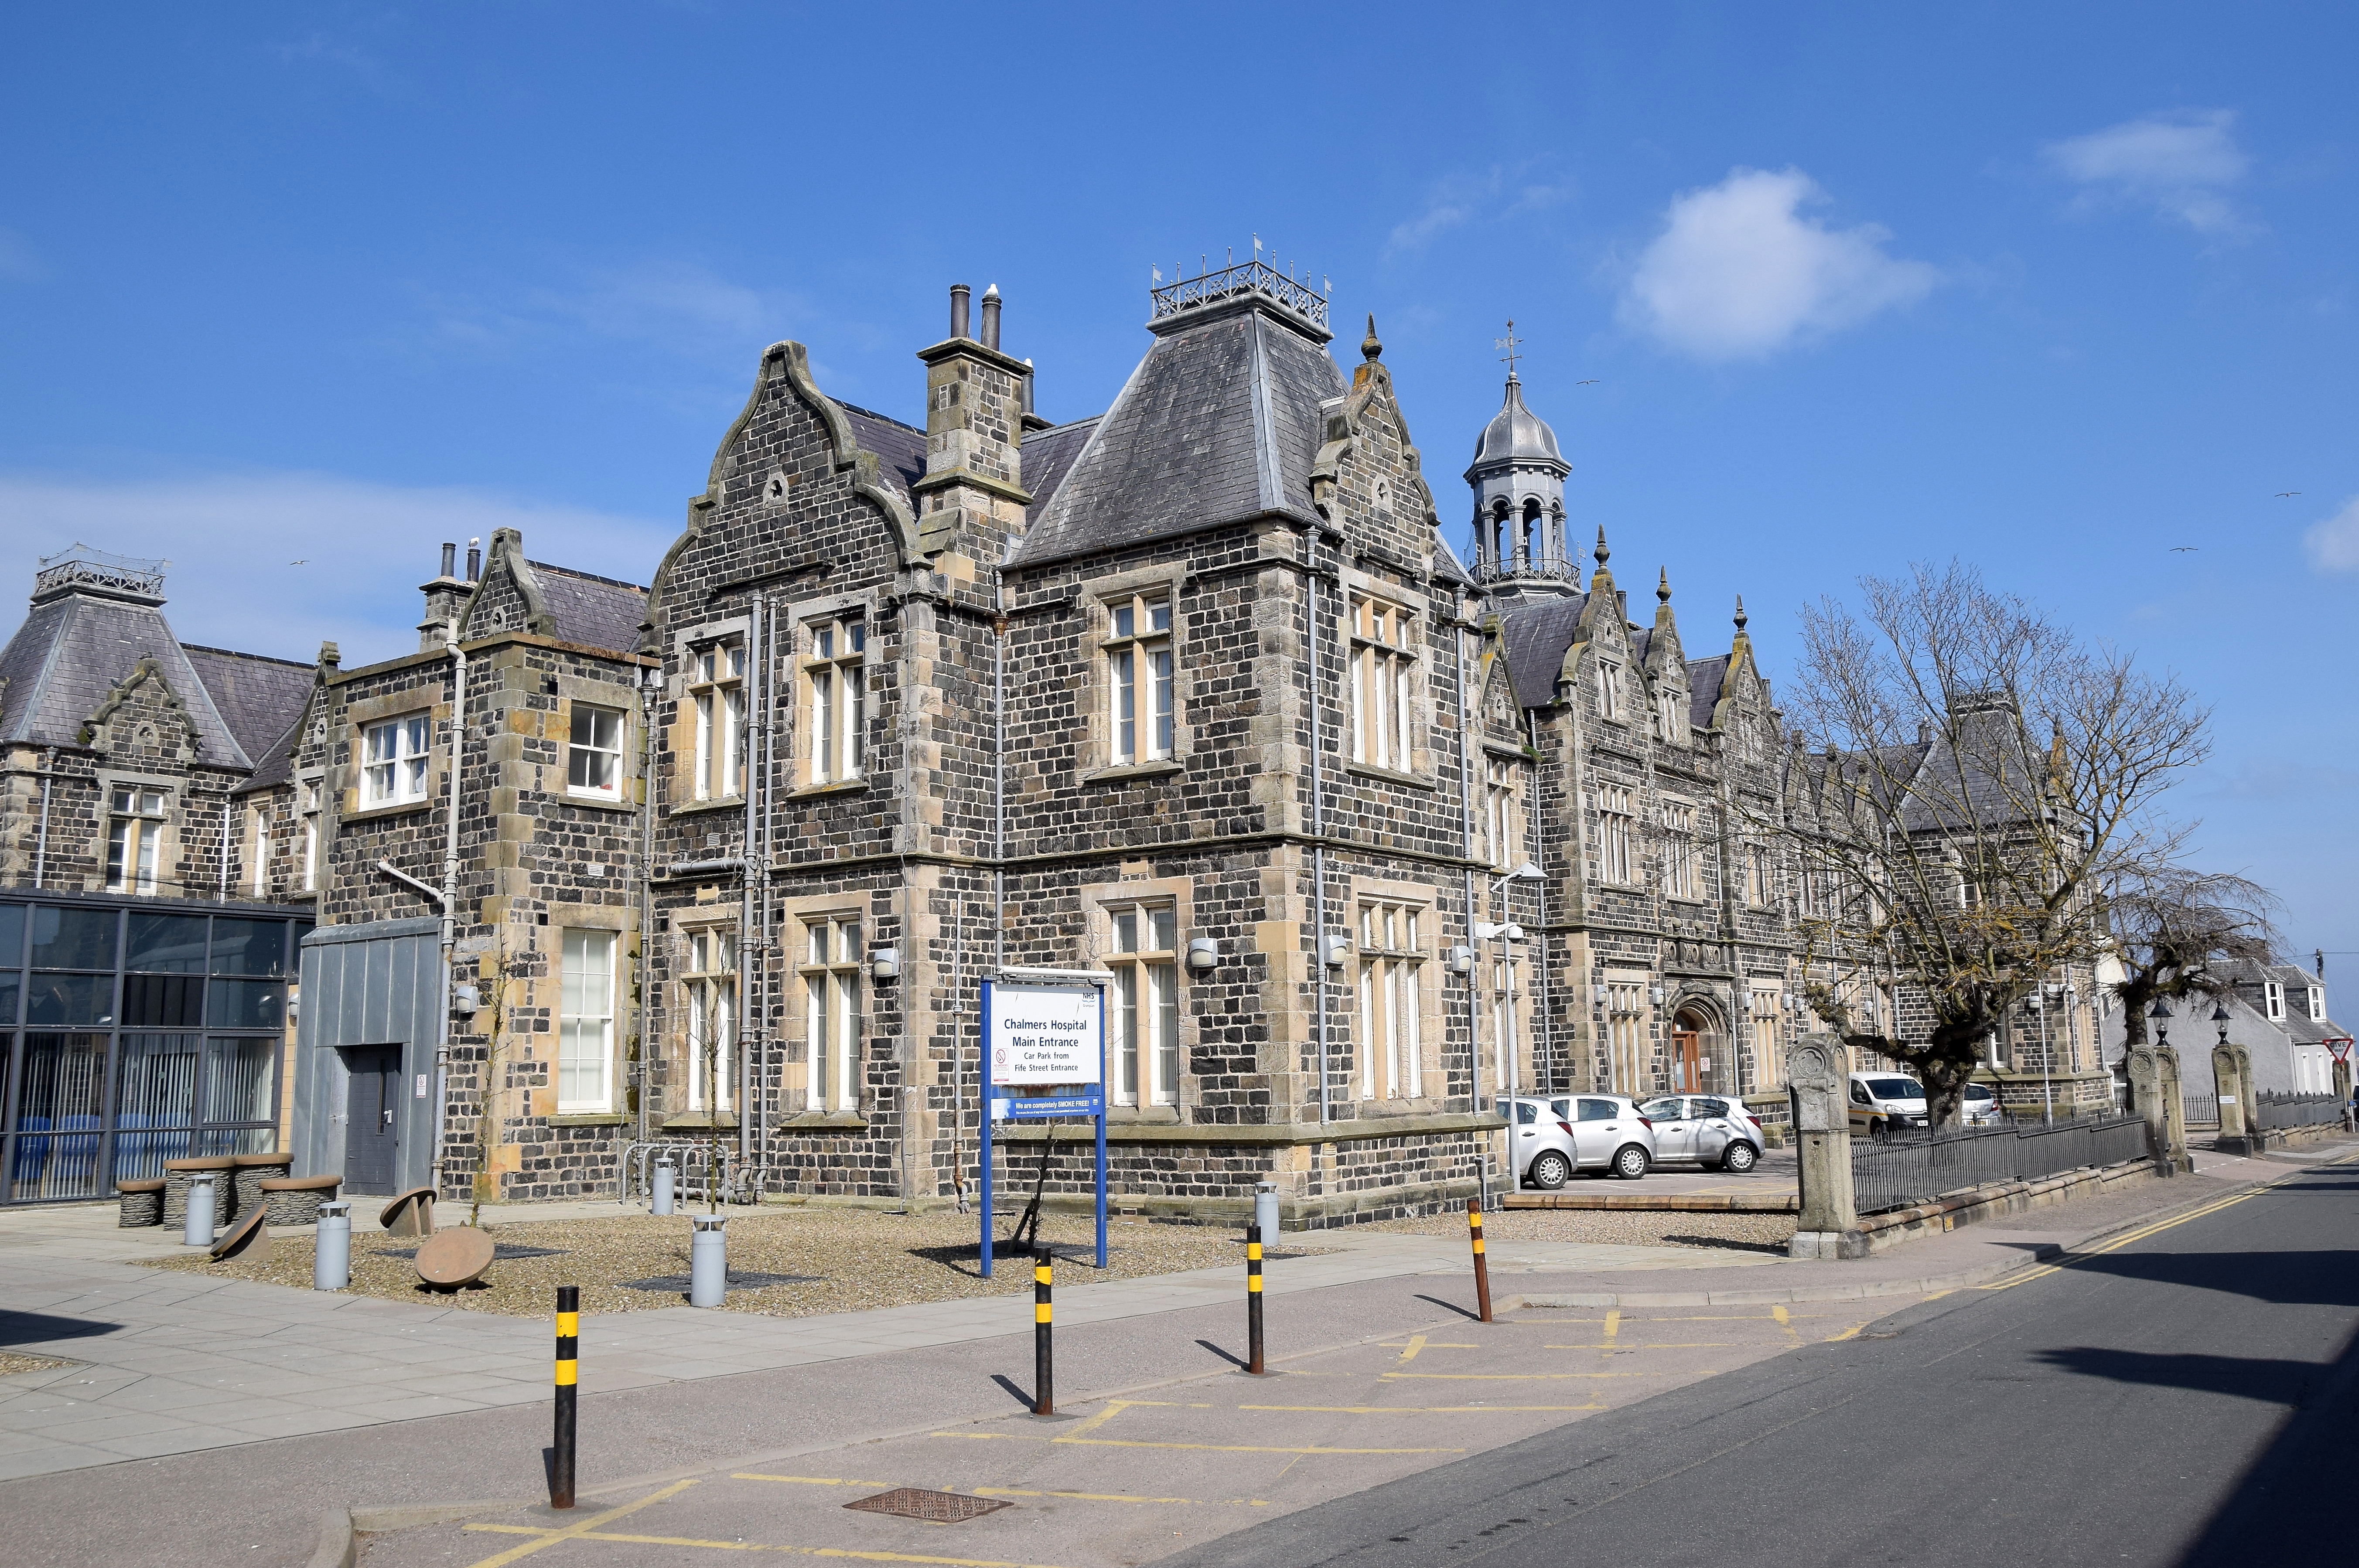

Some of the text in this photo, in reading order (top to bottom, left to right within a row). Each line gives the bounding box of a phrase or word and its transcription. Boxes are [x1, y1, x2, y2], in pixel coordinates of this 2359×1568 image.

[1004, 1019, 1086, 1032] Chalmers Hospital
[1013, 1036, 1079, 1047] Main Entrance
